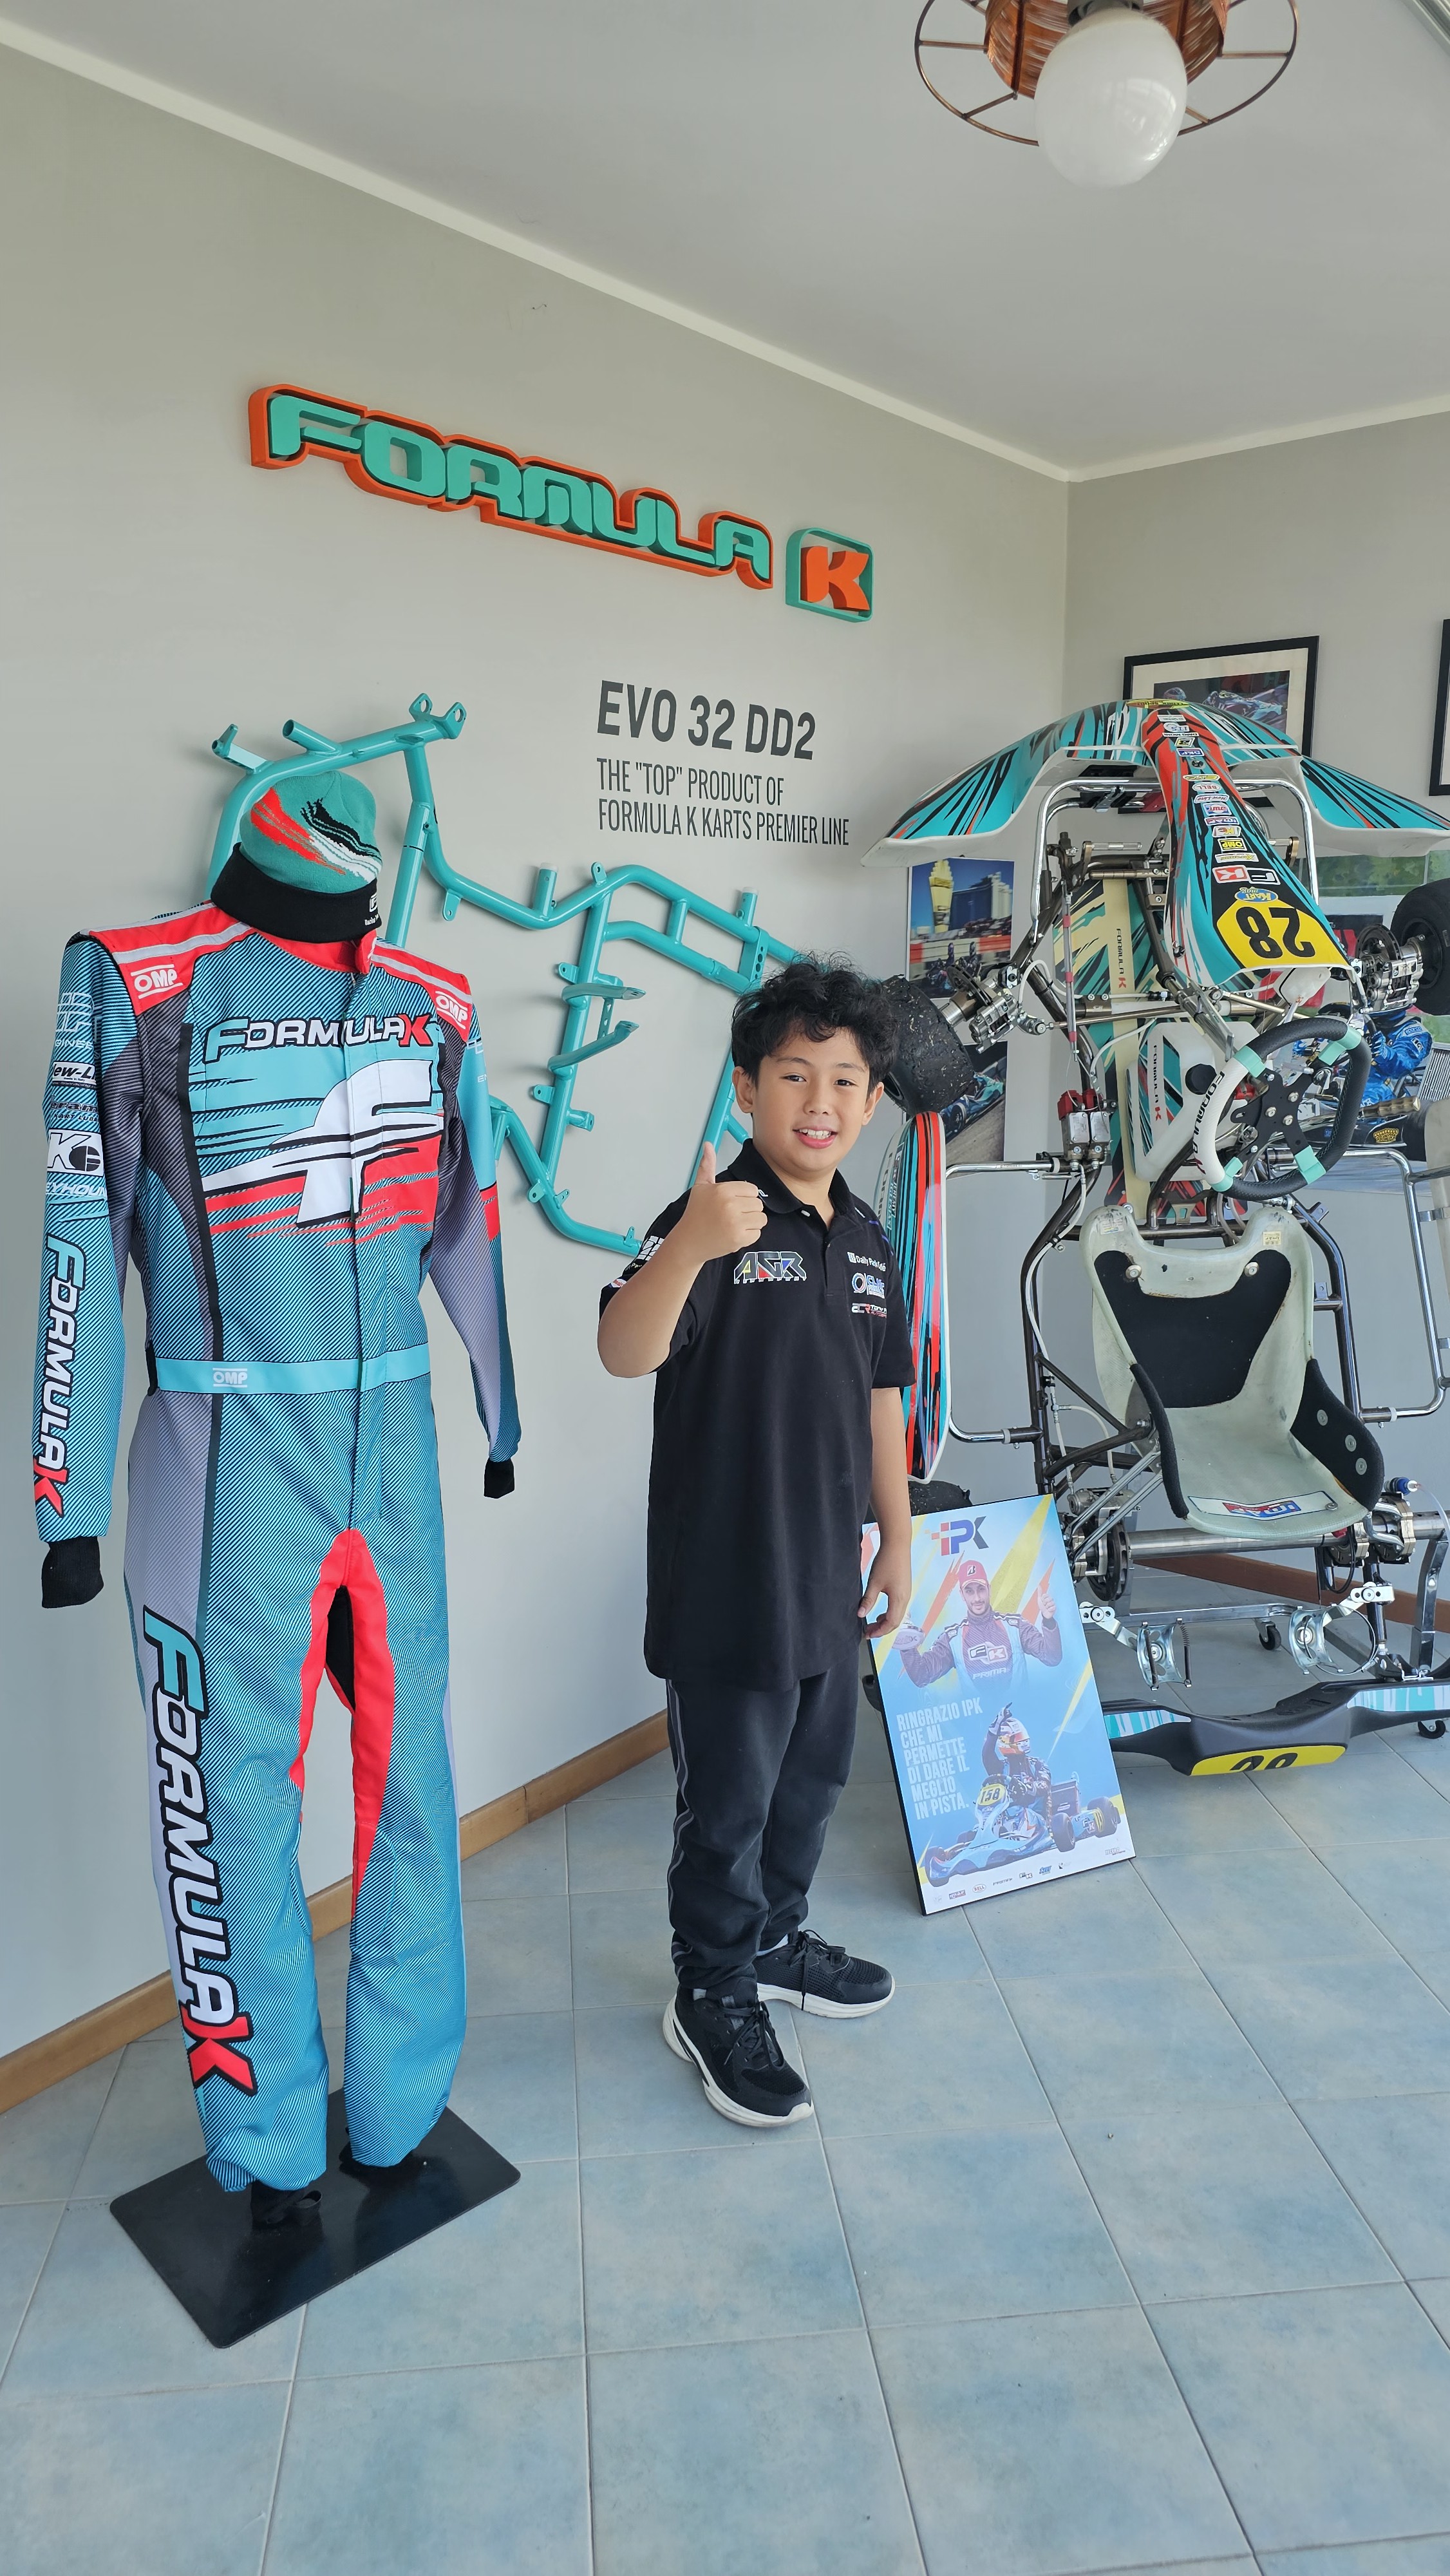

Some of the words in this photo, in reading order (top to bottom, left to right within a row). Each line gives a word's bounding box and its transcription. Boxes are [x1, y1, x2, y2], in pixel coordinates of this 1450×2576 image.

[256, 388, 772, 586] FORMULA
[799, 544, 872, 612] K
[598, 680, 677, 742] EVO
[688, 695, 735, 750] 32
[745, 704, 816, 760] DD2
[597, 758, 630, 792] THE
[636, 762, 683, 796] "TOP"
[688, 768, 762, 804] PRODUCT
[766, 776, 784, 806] OF
[598, 799, 681, 835] FORMULA
[687, 806, 697, 836] K
[702, 807, 752, 839] KARTS
[757, 811, 818, 844] PREMIER
[822, 817, 849, 846] LINE
[1222, 840, 1243, 848] OMP
[1236, 906, 1316, 959] 28
[134, 969, 178, 992] OMP
[1118, 977, 1127, 989] K
[436, 996, 469, 1023] OMP
[1154, 1106, 1162, 1121] K
[1192, 1071, 1226, 1154] FORMULA
[213, 1371, 248, 1385] OMP
[972, 1667, 1007, 1680] PRIMA
[896, 1702, 960, 1732] RINGRAZIO
[961, 1697, 983, 1717] IPK
[900, 1727, 926, 1749] CHE
[927, 1724, 943, 1743] MI
[903, 1736, 966, 1767] PERMETTE
[907, 1765, 921, 1785] DI
[923, 1757, 956, 1781] DARE
[957, 1755, 970, 1772] IL
[910, 1776, 956, 1803] MEGLIO
[979, 1787, 1001, 1804] 158
[914, 1801, 930, 1821] IN
[930, 1792, 970, 1816] PISTA.
